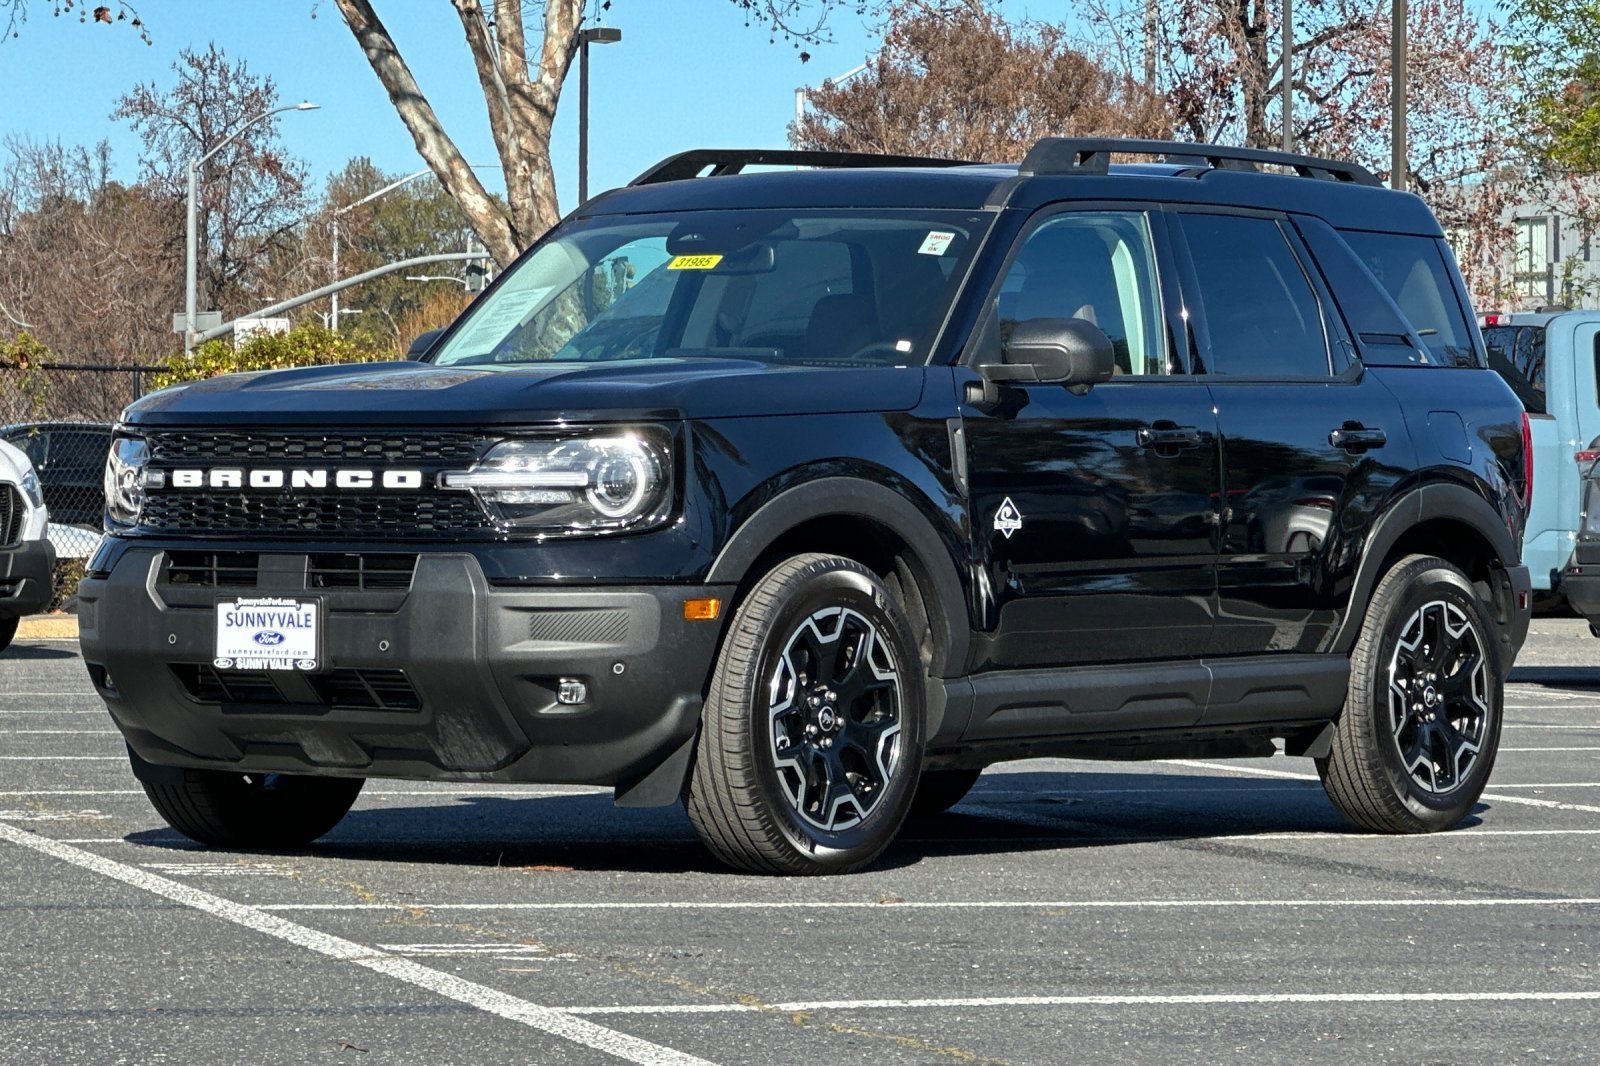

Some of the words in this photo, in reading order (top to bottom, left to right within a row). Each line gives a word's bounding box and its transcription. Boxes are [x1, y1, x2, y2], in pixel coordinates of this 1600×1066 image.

[674, 256, 713, 268] 31985
[172, 469, 422, 488] BRONCO
[226, 612, 312, 628] SUNNYVALE
[235, 657, 294, 670] SUNNYVALE
